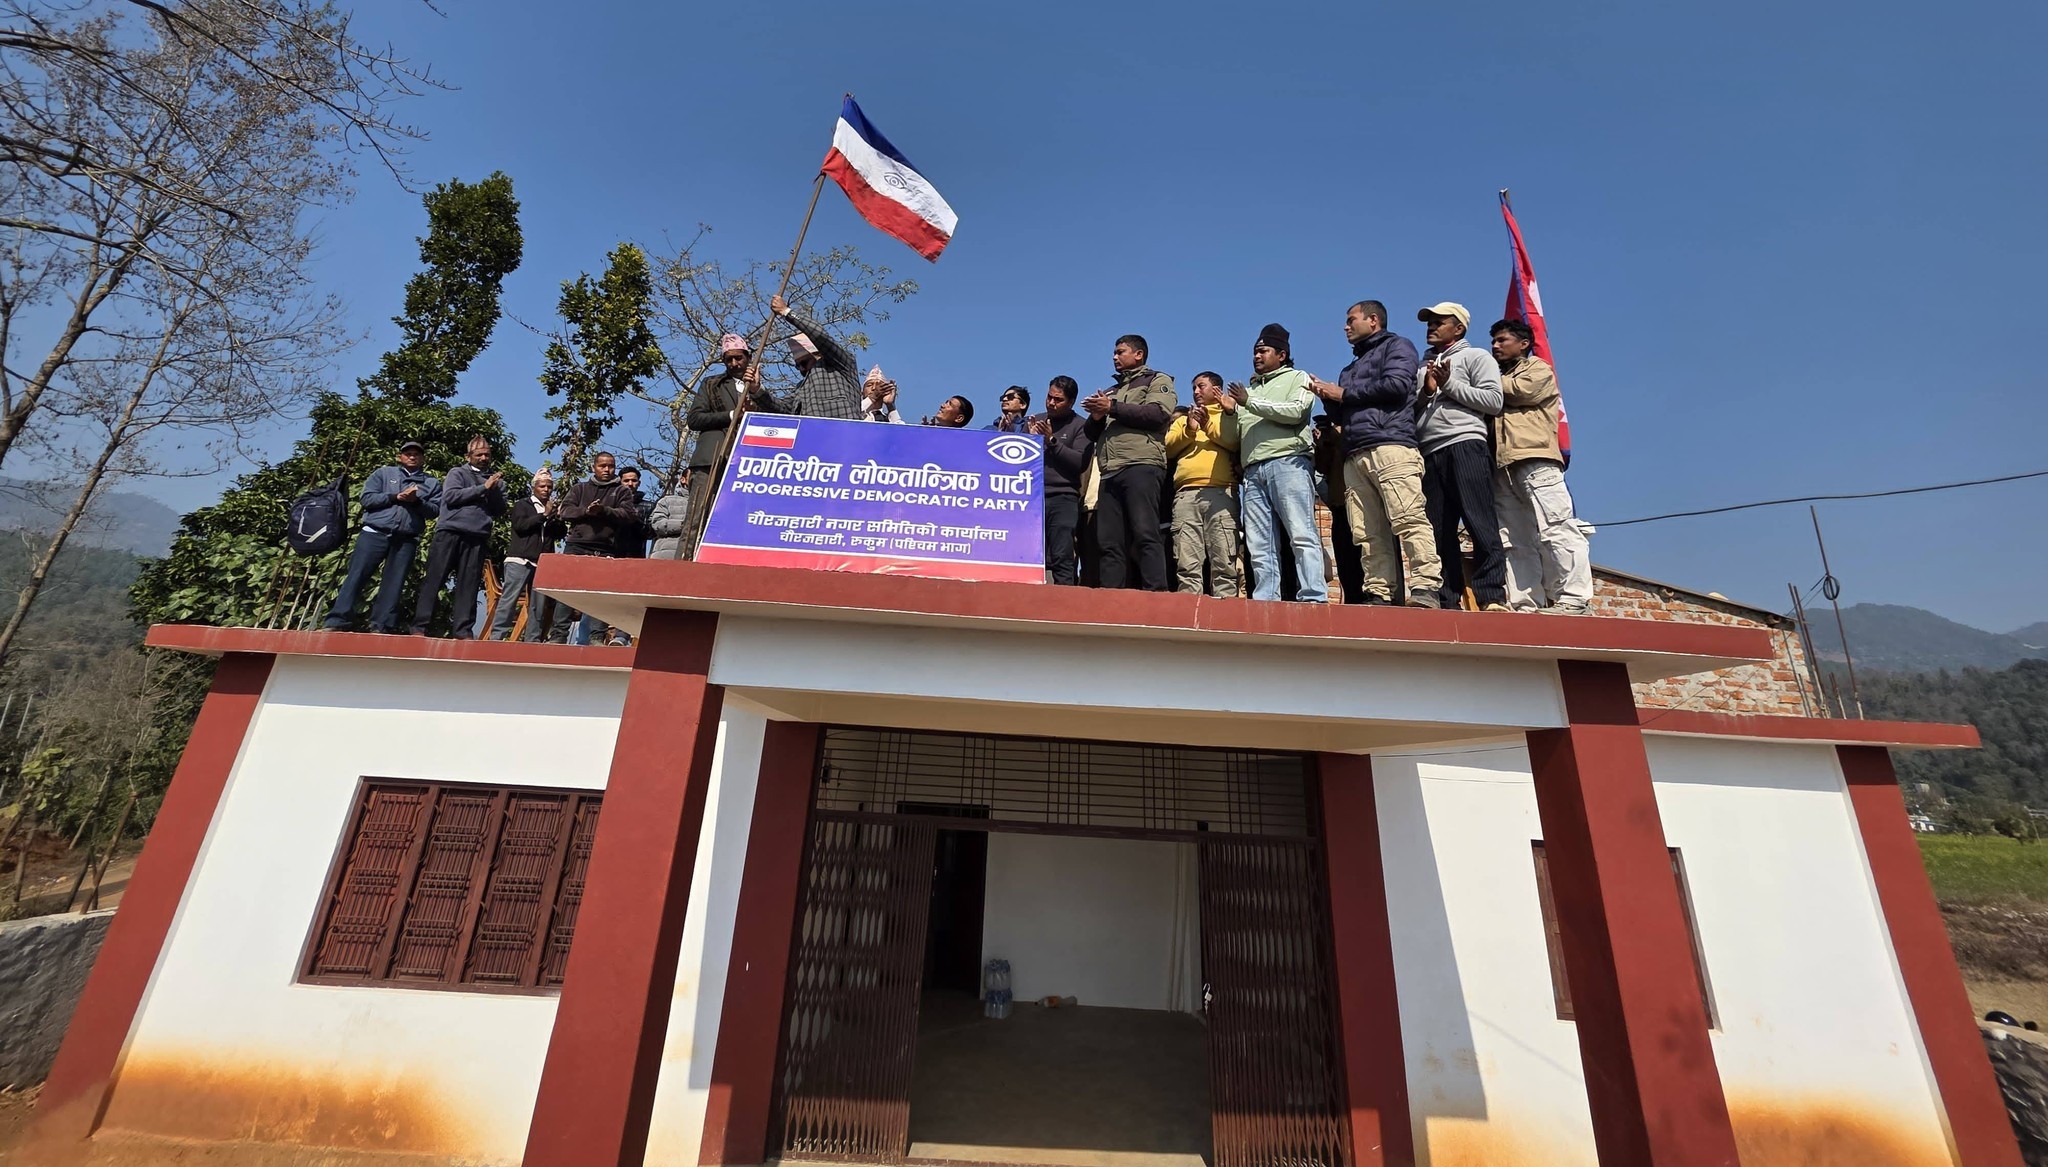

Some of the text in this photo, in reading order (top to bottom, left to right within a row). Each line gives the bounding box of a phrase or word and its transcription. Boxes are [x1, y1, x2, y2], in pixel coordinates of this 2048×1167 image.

[737, 453, 1034, 495] प्रगतिशील लोकतान्त्रिक पार्टी
[731, 481, 1030, 512] PROGRESSIVE DEMOCRATIC PARTY
[747, 511, 1009, 542] चौरजहारी नगर समितिको कार्यालय
[940, 542, 972, 555] भाग)
